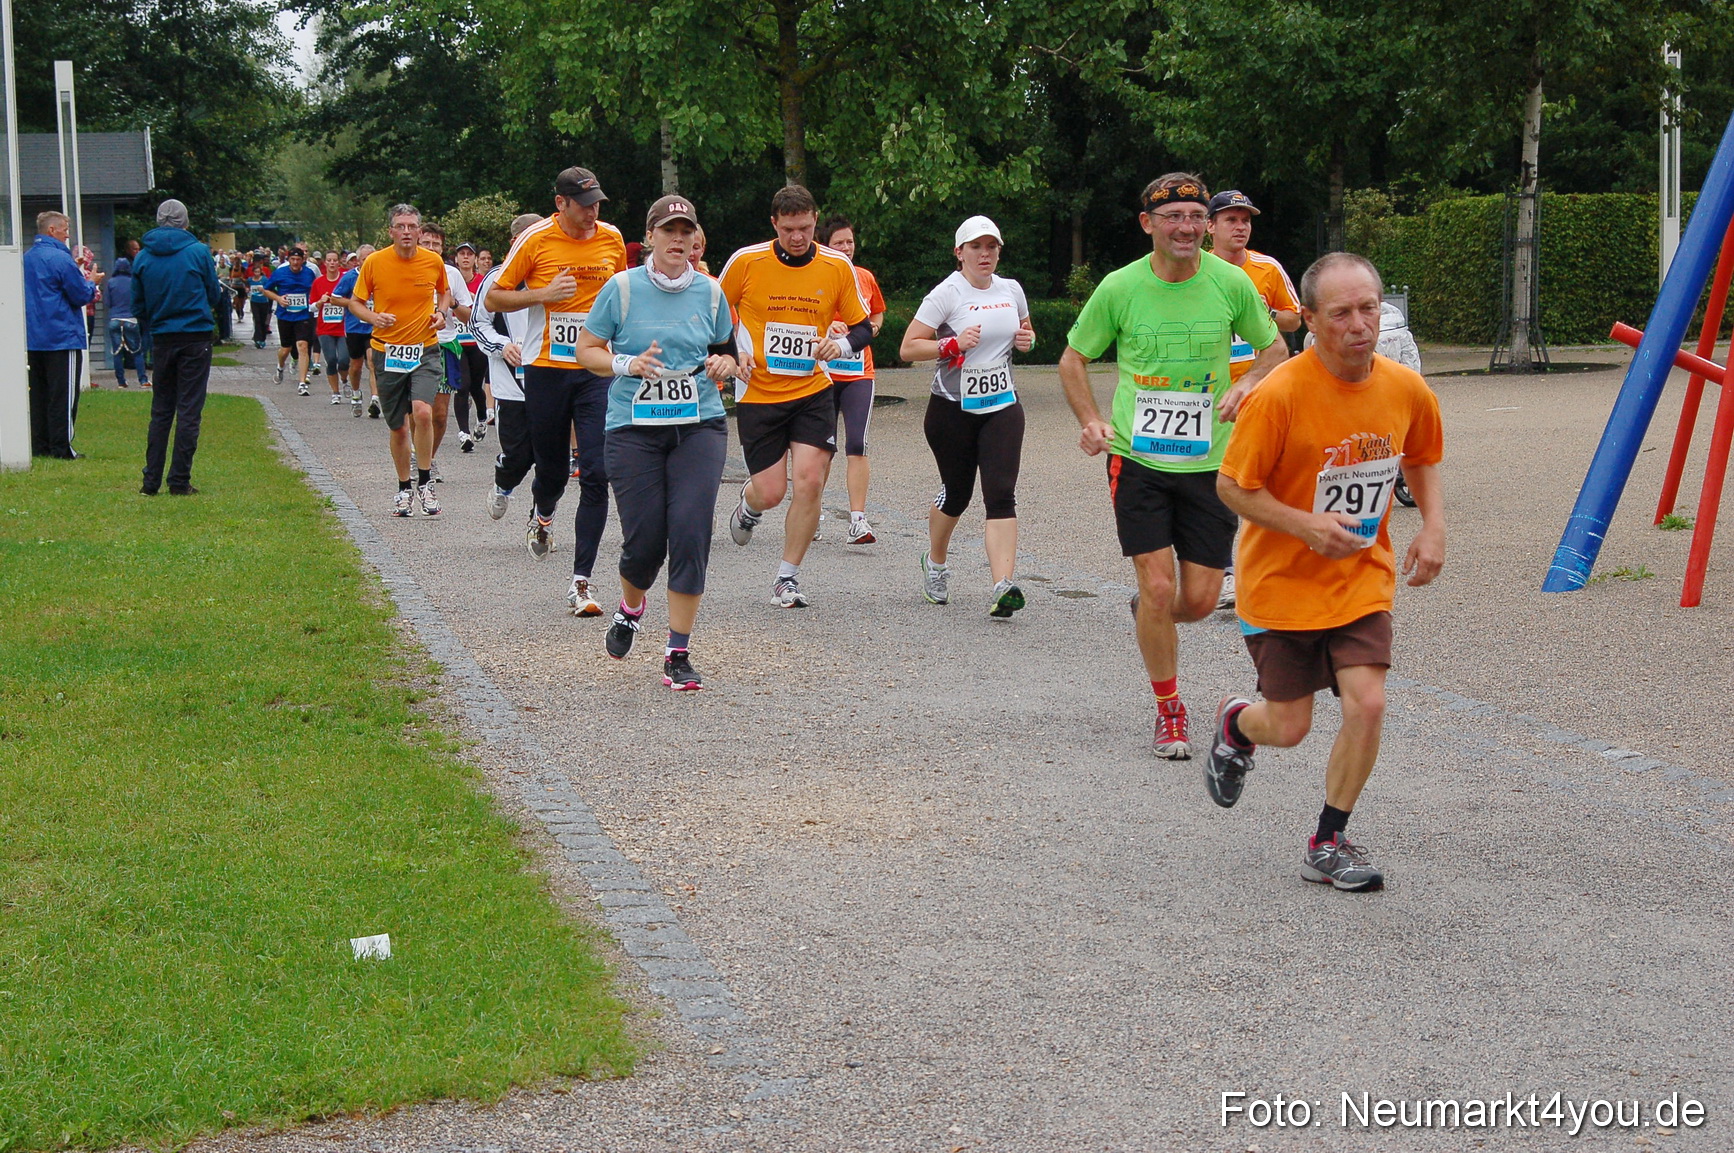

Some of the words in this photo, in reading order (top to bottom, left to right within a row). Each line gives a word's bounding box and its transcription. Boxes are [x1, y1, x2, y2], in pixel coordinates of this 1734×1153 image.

[668, 203, 688, 213] GAP
[798, 296, 820, 304] Notärzte
[324, 307, 343, 315] 2732
[769, 335, 814, 357] 2981
[389, 345, 420, 360] 2499
[774, 359, 806, 369] Christian
[981, 366, 1001, 374] Neumarkt
[967, 371, 1008, 395] 2693
[639, 379, 692, 400] 2186
[980, 397, 998, 406] Birgit
[1136, 396, 1162, 404] PARTL
[1164, 398, 1200, 407] Neumarkt
[651, 406, 682, 416] Kathrin
[1141, 407, 1202, 436] 2721
[1150, 441, 1192, 454] Manfred
[1319, 472, 1350, 483] PARTL
[1352, 466, 1394, 479] Neumarkt
